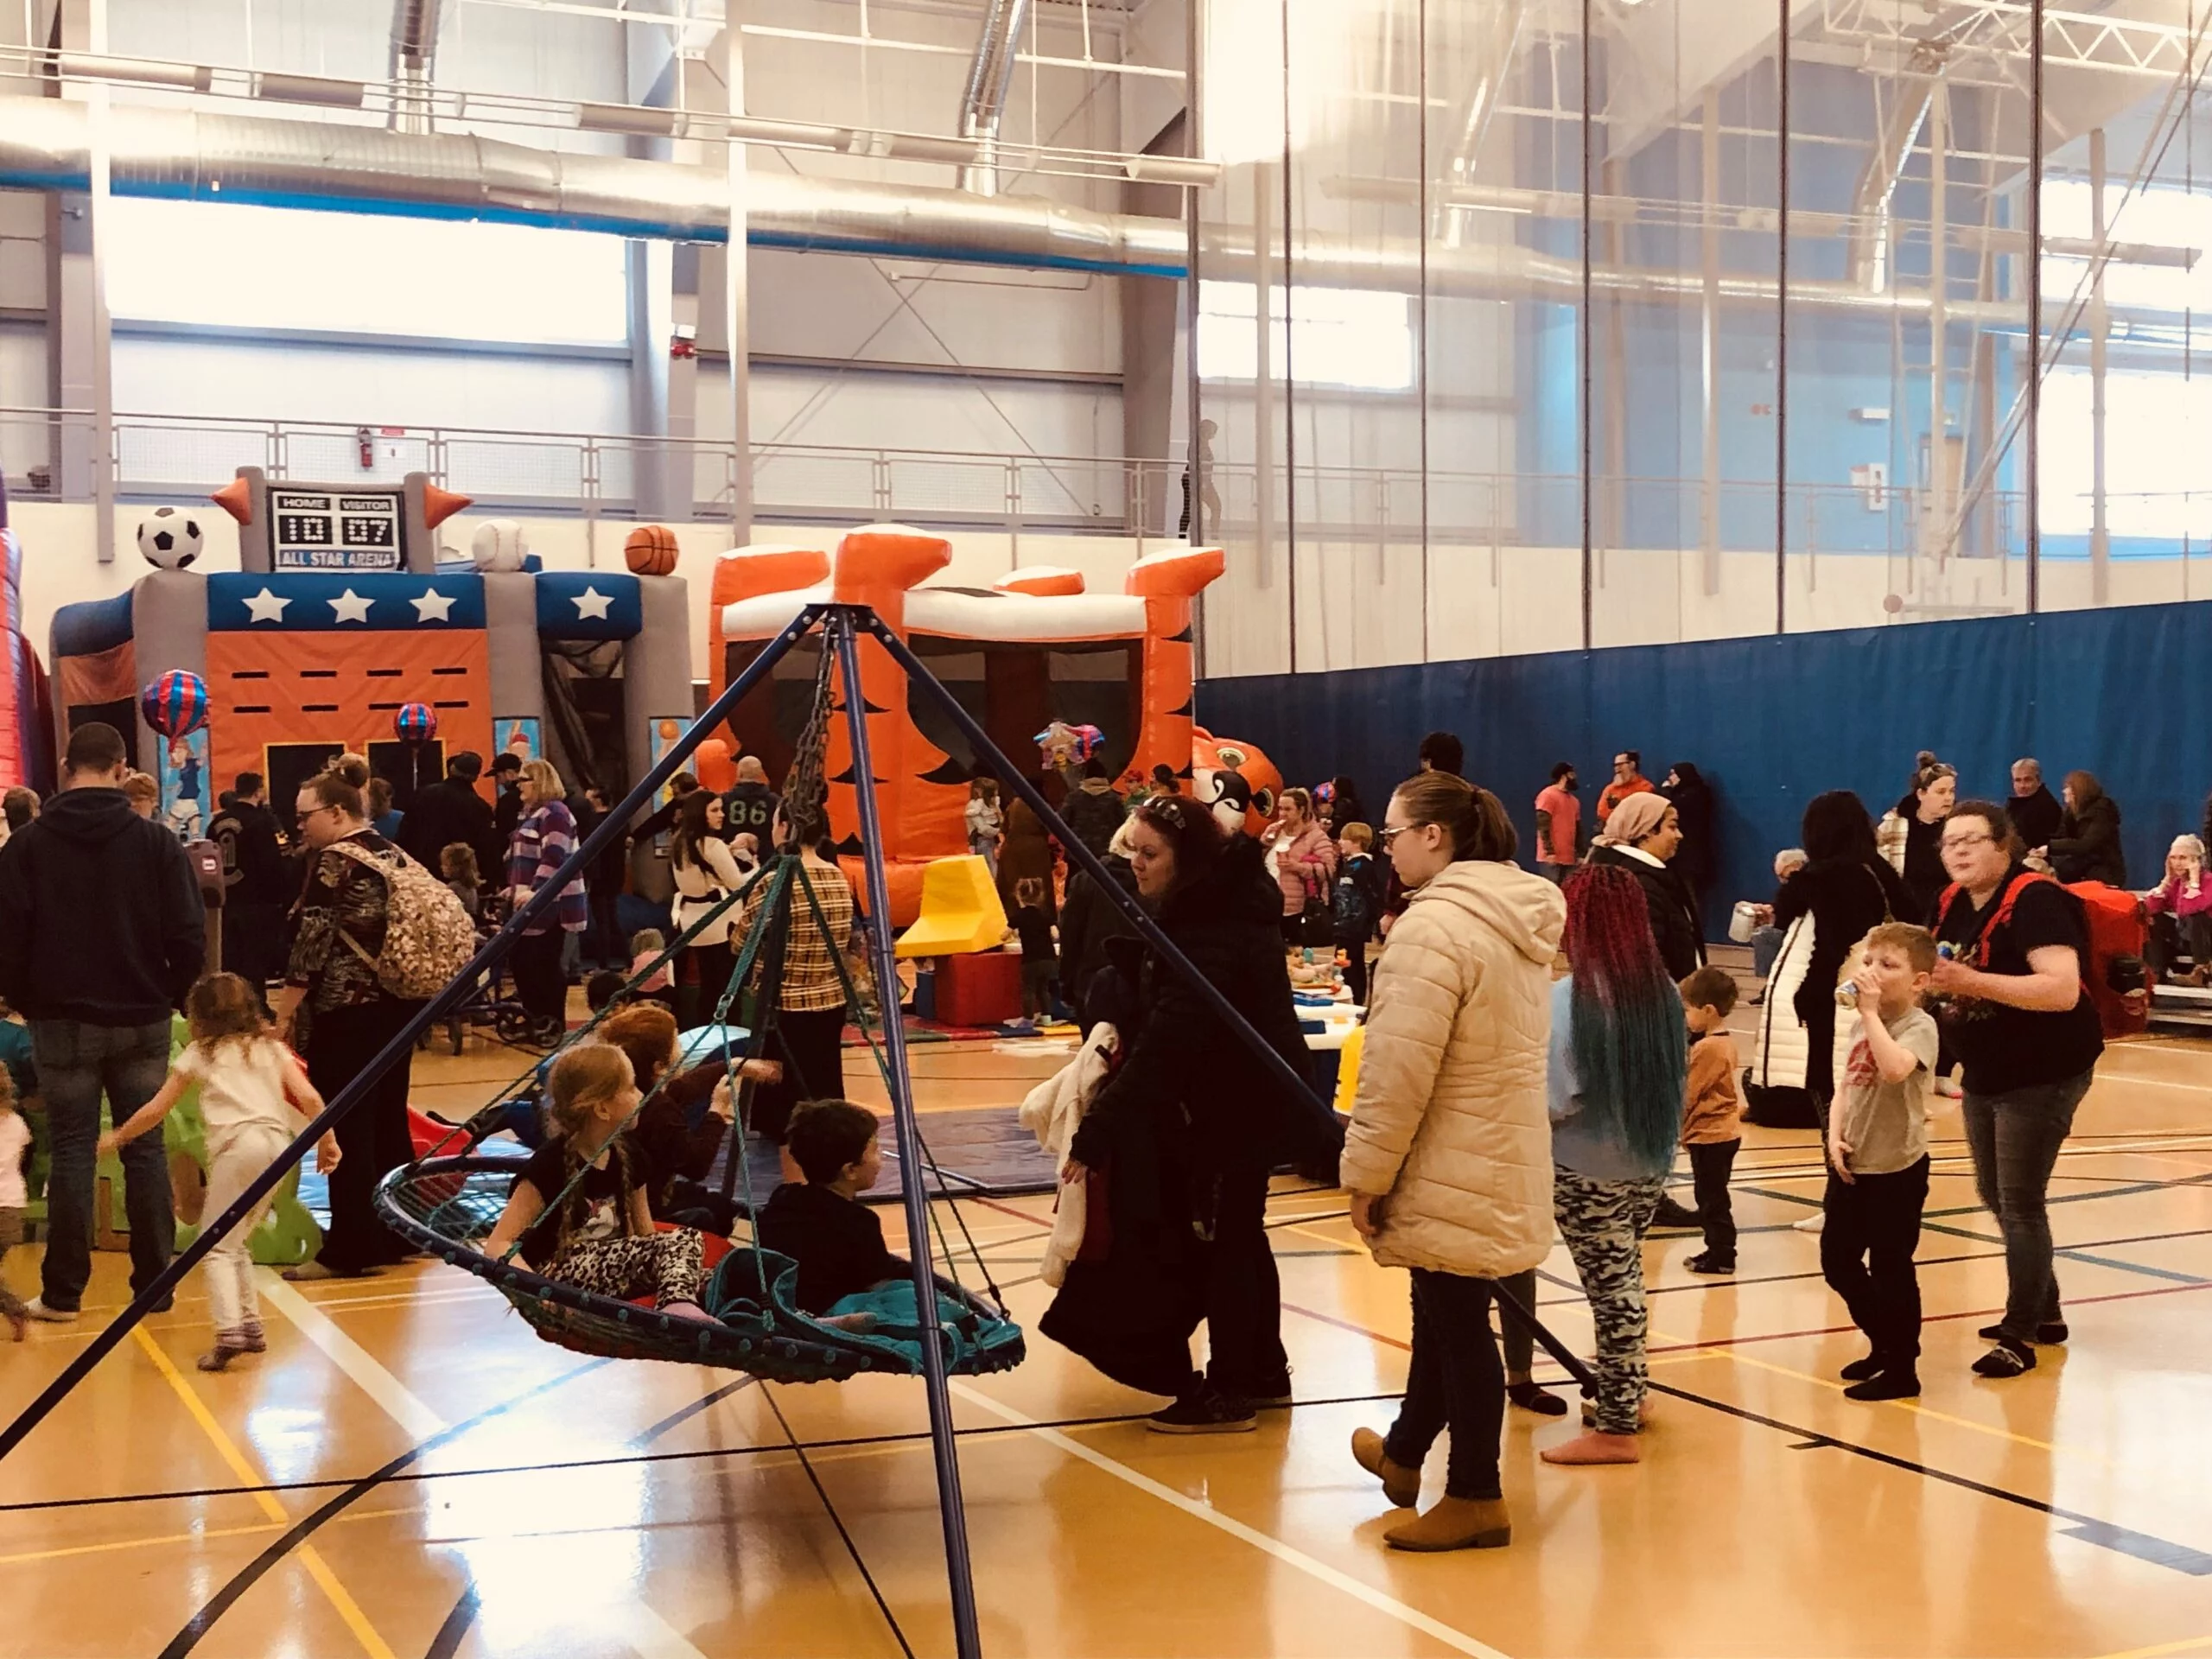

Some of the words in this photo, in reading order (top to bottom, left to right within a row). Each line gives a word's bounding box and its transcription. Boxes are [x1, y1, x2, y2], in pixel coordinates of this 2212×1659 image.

[283, 498, 326, 508] HOME
[342, 500, 390, 510] VISITOR
[289, 518, 324, 541] 10
[348, 519, 388, 543] 07
[282, 552, 306, 565] ALL
[310, 552, 345, 566] STAR
[347, 553, 391, 566] ARENA
[728, 800, 767, 825] 86
